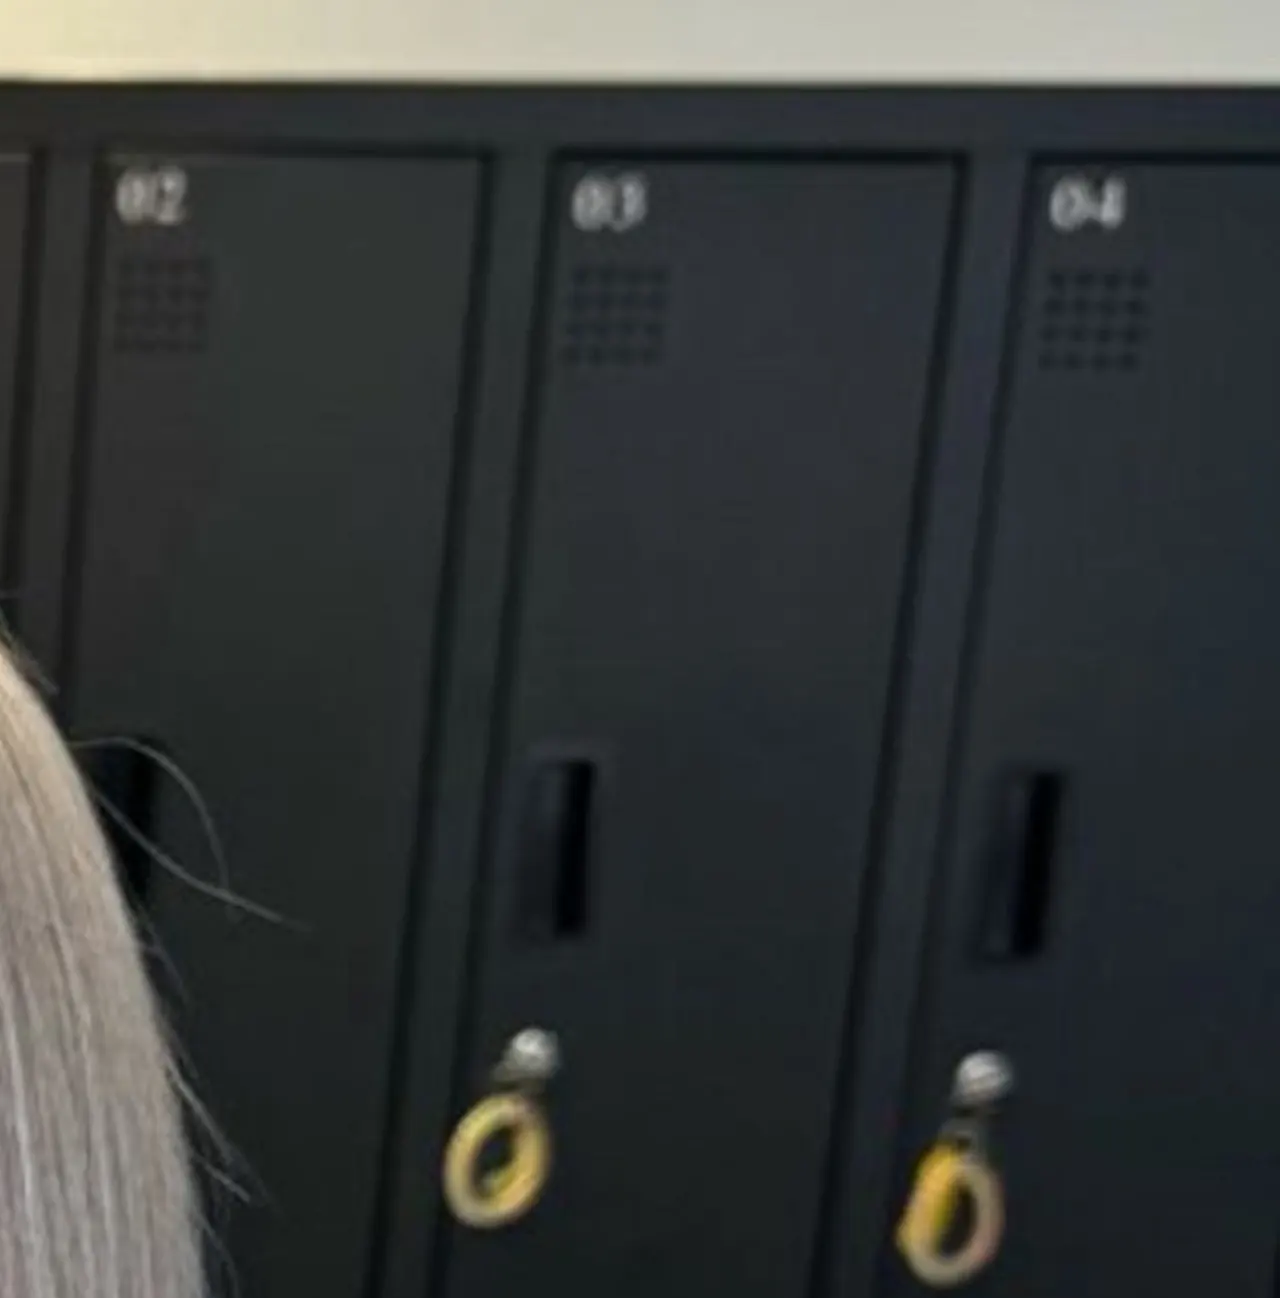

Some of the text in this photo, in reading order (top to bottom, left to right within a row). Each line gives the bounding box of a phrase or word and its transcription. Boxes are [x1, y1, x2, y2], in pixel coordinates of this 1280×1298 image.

[115, 165, 187, 225] 02
[571, 171, 648, 232] 03
[1050, 173, 1126, 233] 04
